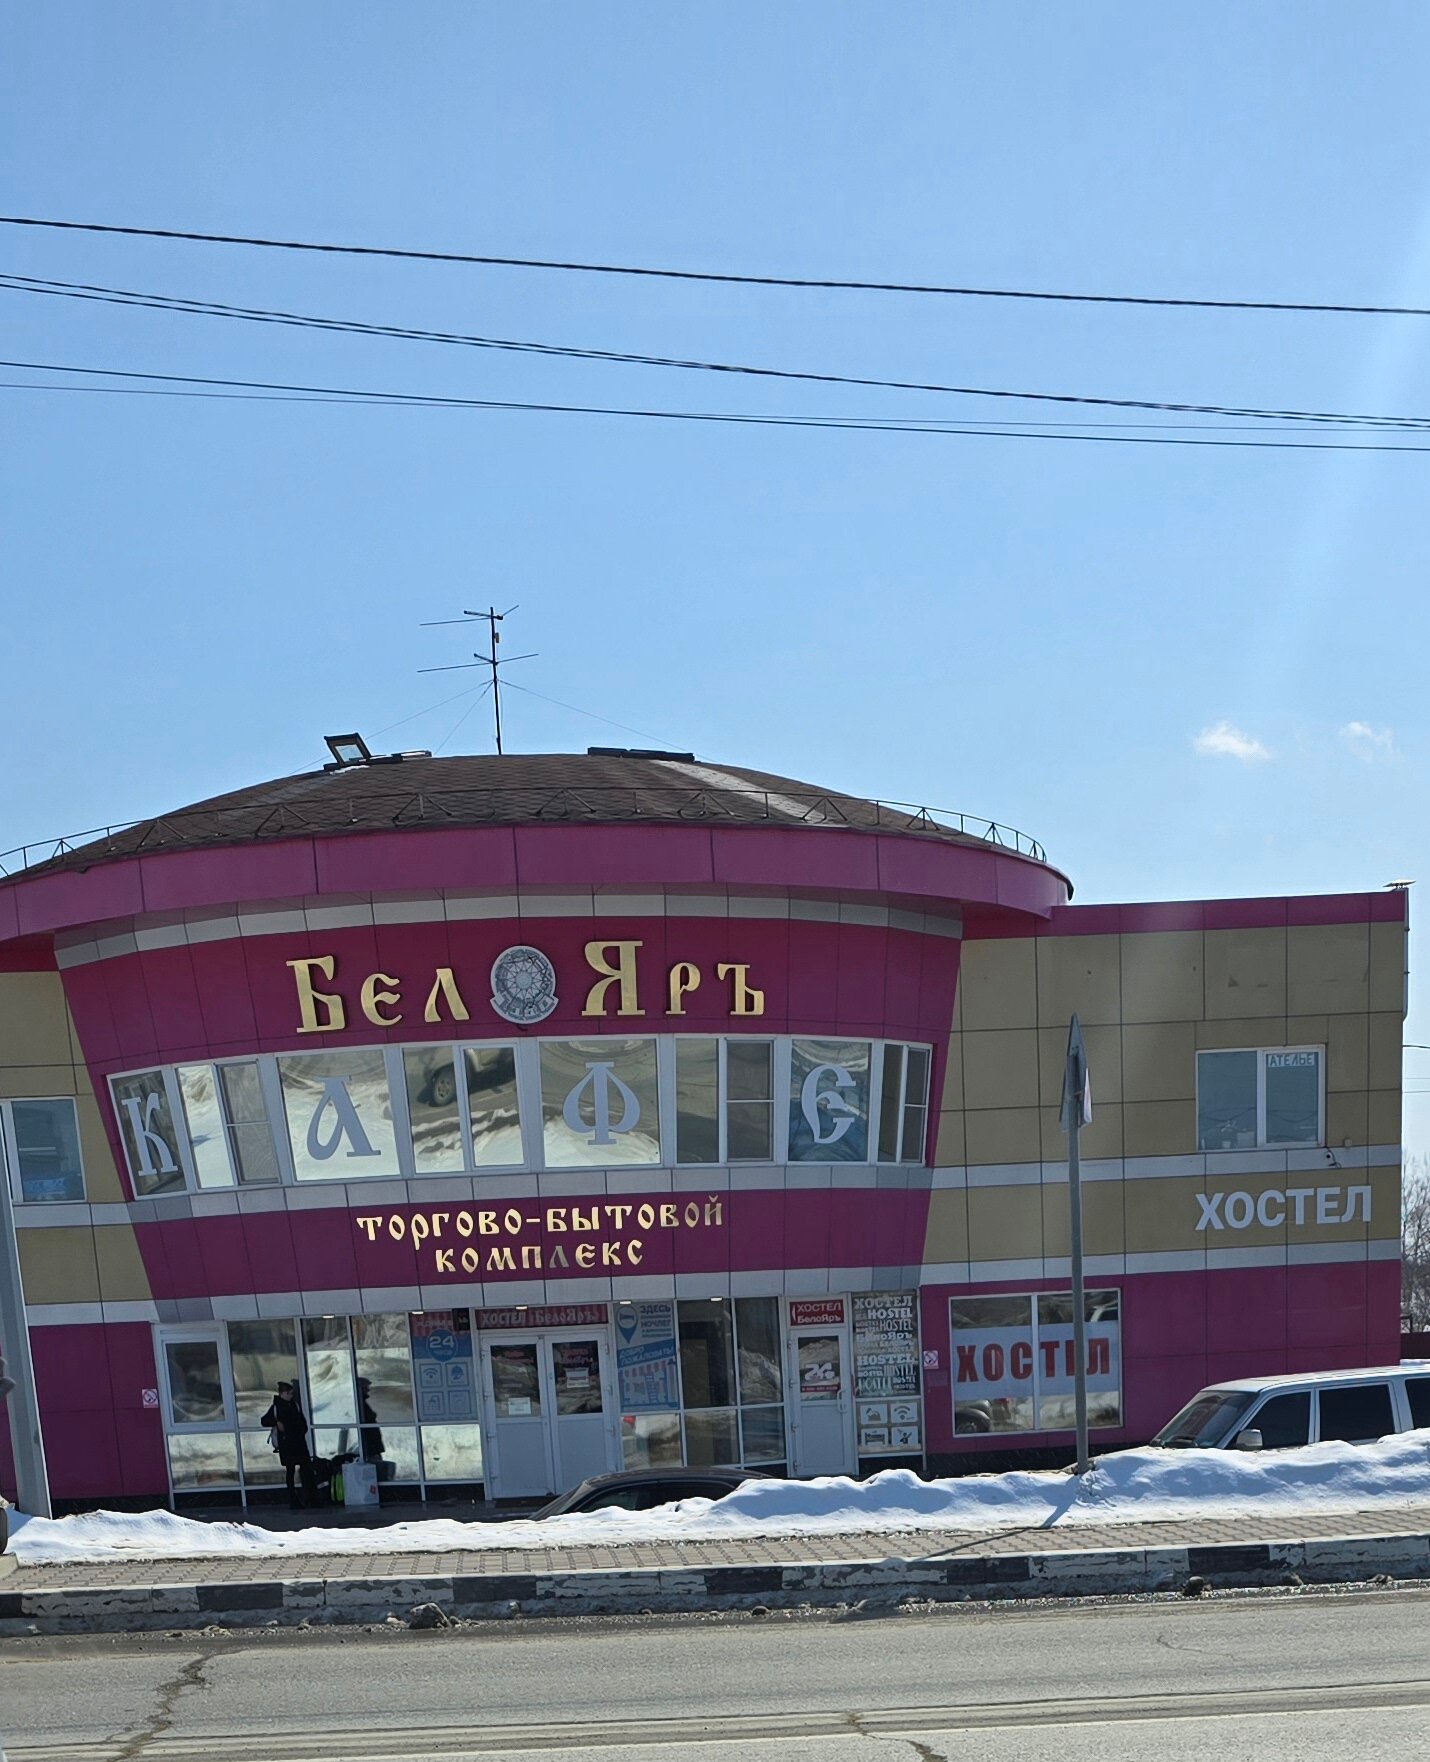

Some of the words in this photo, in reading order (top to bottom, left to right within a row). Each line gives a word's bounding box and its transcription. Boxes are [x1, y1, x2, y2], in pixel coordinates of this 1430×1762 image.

[1269, 1053, 1314, 1067] АТЕЛЬЕ
[1195, 1185, 1372, 1231] ХОСТЕЛ
[434, 1239, 643, 1273] КОМПЛЕКС
[640, 1304, 671, 1314] ЗДЕСЬ
[797, 1303, 842, 1312] ХОСТЕЛ
[855, 1296, 912, 1309] ХОСТЕЛ
[867, 1307, 913, 1320] HOSTEL
[880, 1319, 914, 1331] HOSTEL
[430, 1335, 455, 1349] 24
[857, 1354, 914, 1366] HOSTEL
